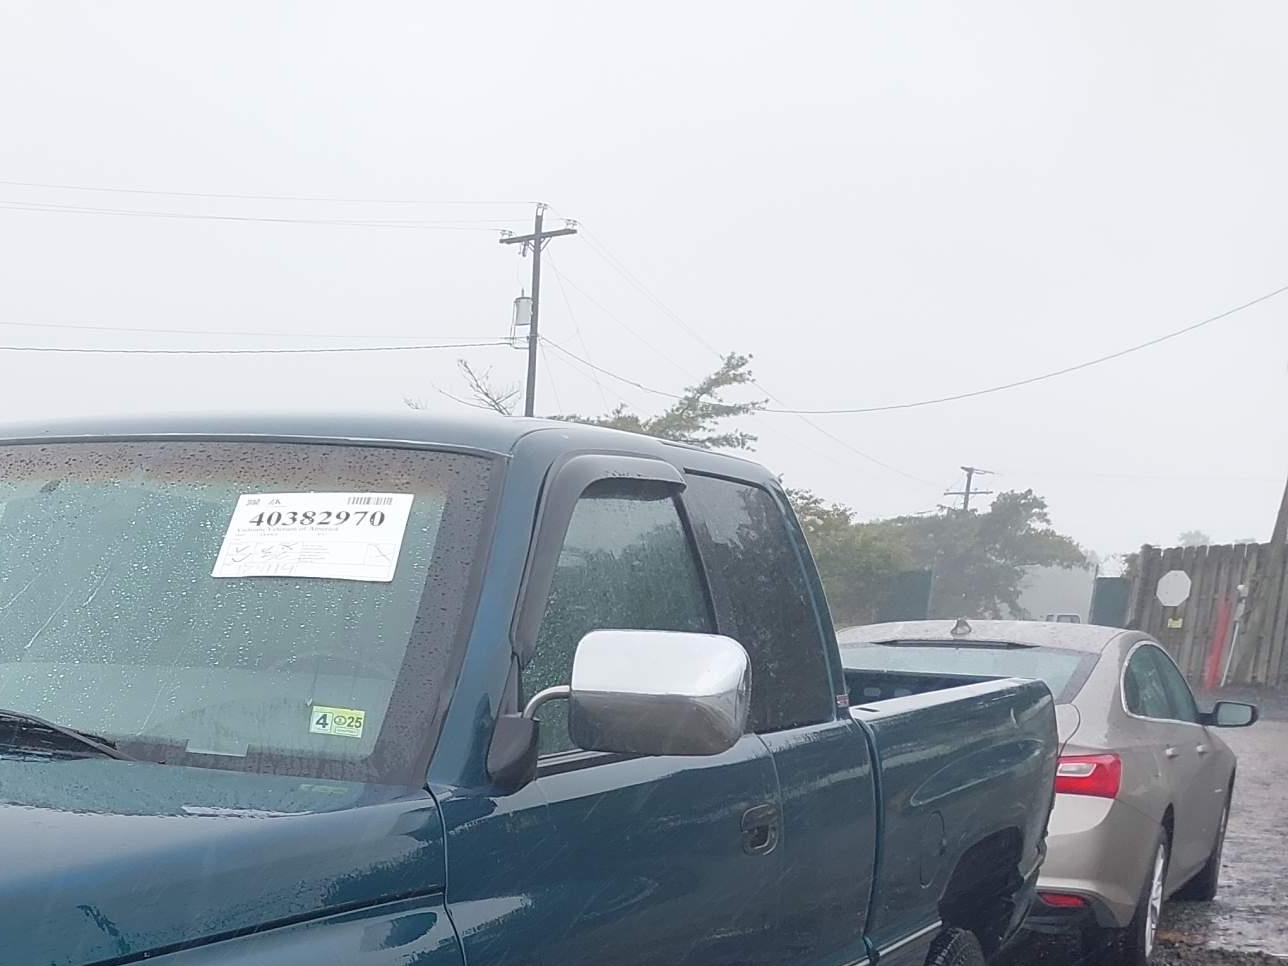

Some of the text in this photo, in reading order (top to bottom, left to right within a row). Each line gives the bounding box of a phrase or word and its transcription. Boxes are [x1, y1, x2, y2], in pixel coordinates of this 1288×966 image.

[248, 510, 386, 527] 40382970
[315, 713, 363, 729] 4 25
